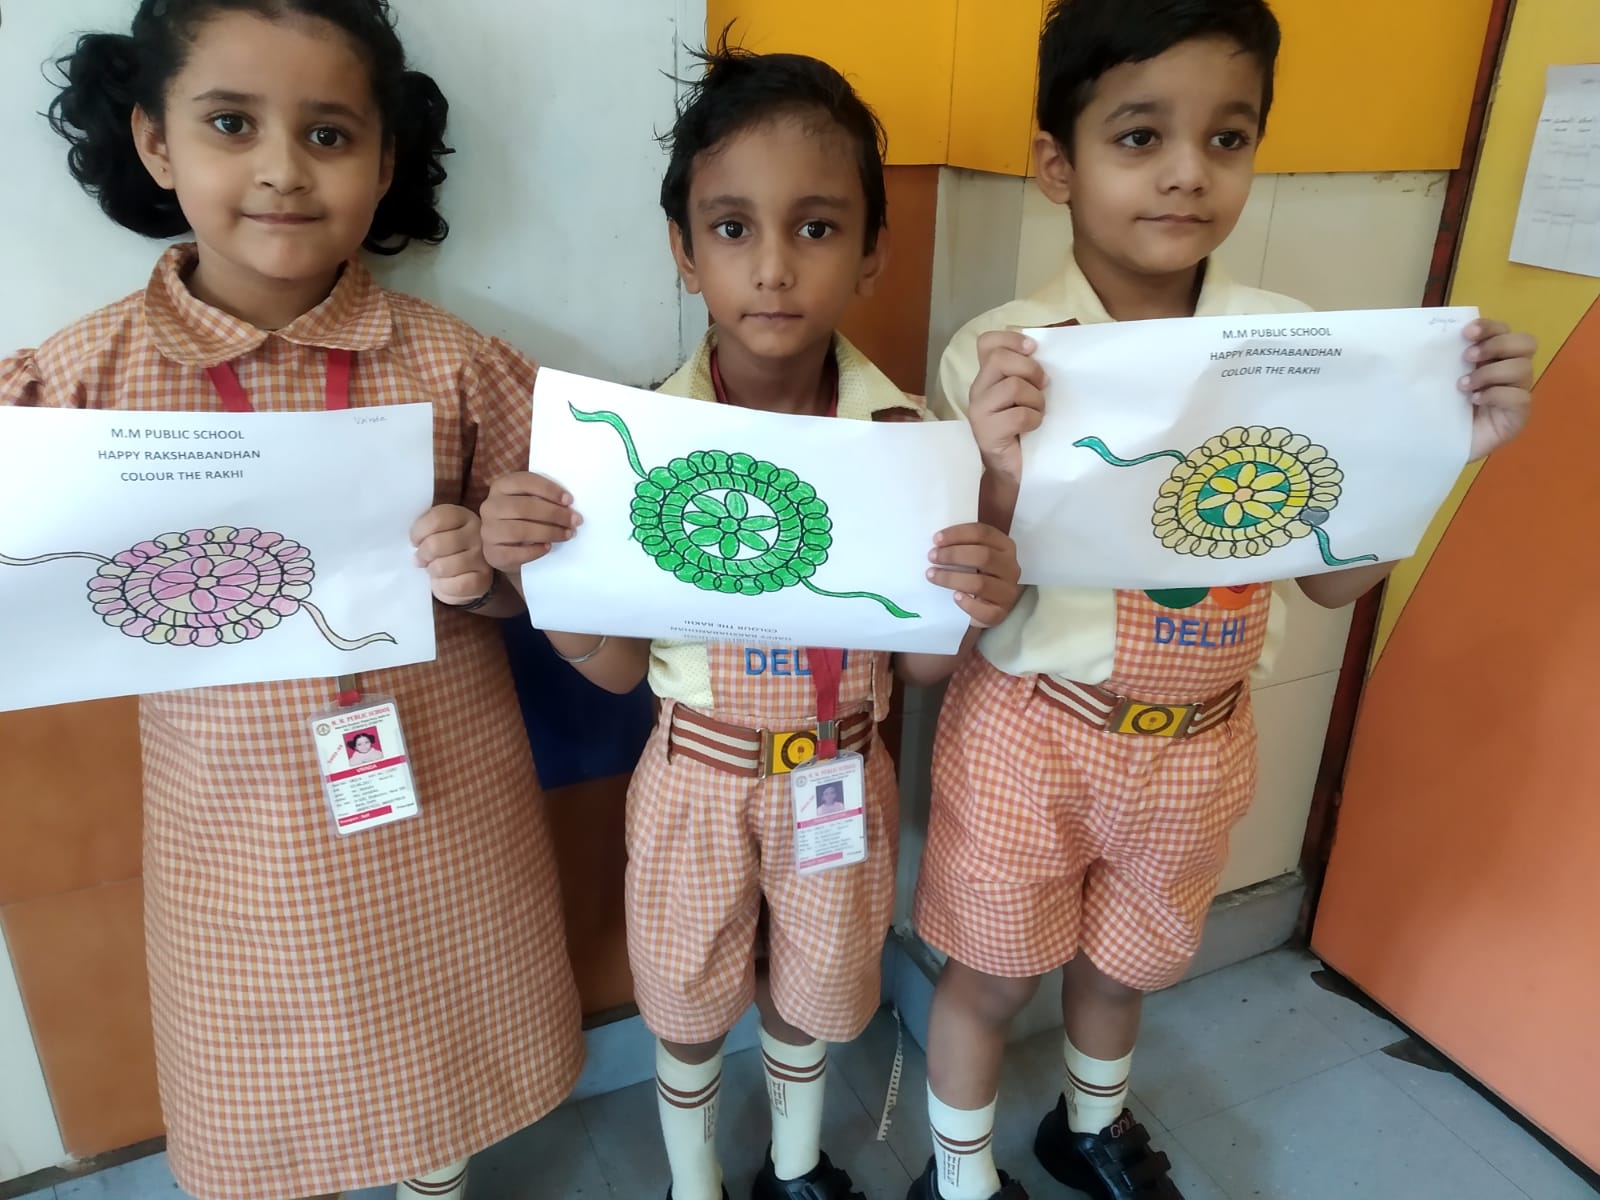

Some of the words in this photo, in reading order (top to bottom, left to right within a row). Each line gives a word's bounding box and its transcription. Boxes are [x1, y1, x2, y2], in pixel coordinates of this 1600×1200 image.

[1222, 329, 1248, 339] M.M
[1251, 328, 1288, 338] PUBLIC
[1290, 327, 1333, 337] SCHOOL
[1210, 349, 1243, 361] HAPPY
[1245, 348, 1342, 358] RAKSHABANDHAN
[1221, 366, 1262, 378] COLOUR
[1265, 366, 1285, 375] THE
[1288, 366, 1321, 375] RAKHI
[111, 428, 141, 439] M.M
[145, 429, 190, 440] PUBLIC
[193, 429, 245, 440] SCHOOL
[98, 449, 140, 461] HAPPY
[144, 449, 261, 461] RAKSHABANDHAN
[120, 471, 175, 482] COLOUR
[177, 470, 202, 481] THE
[205, 469, 244, 480] RAKHI
[684, 620, 714, 628] RAKHI
[737, 625, 778, 634] COLOUR
[1154, 616, 1246, 648] DELHI
[744, 647, 848, 676] DELI
